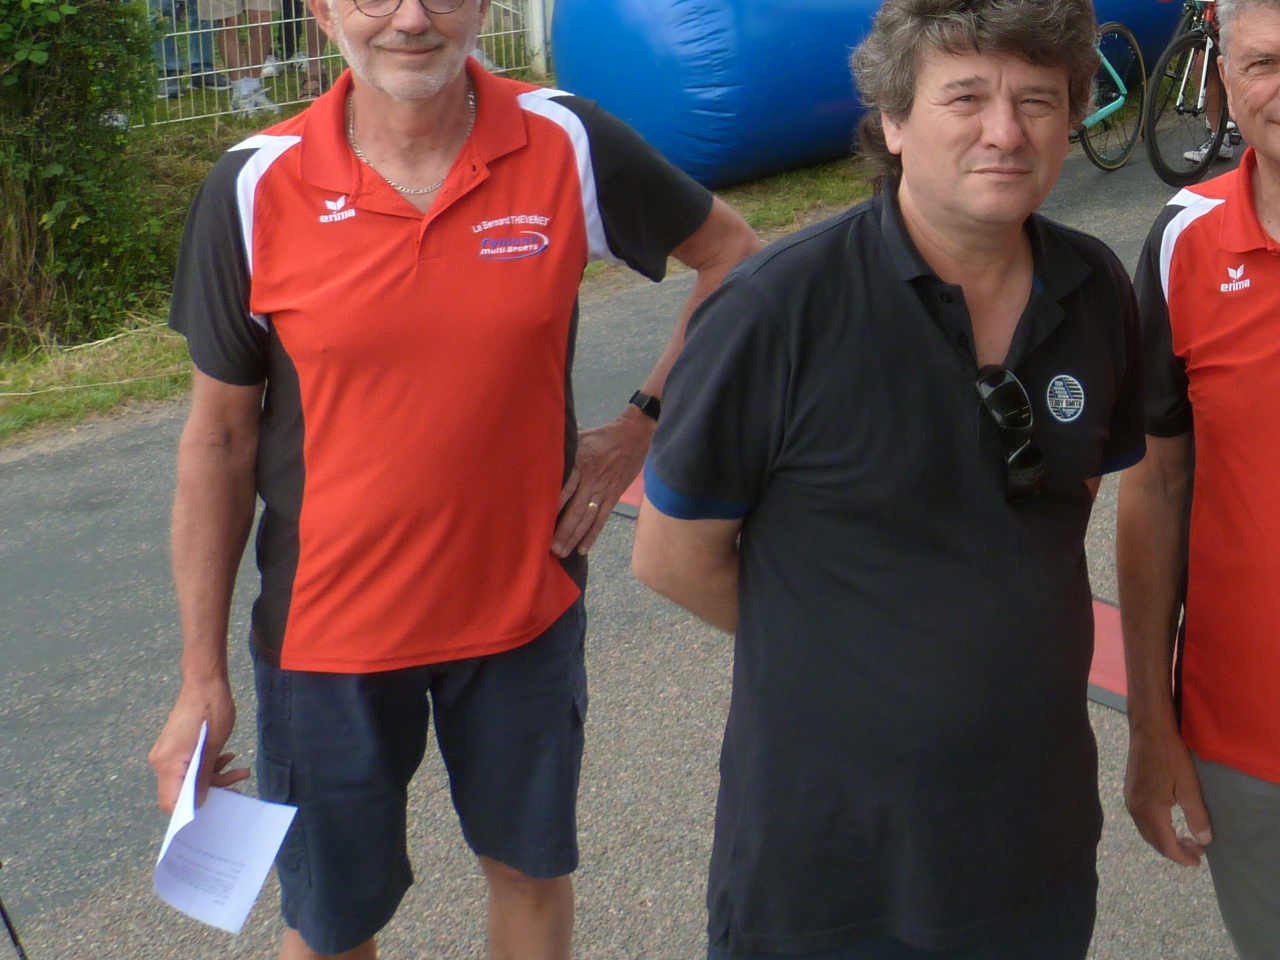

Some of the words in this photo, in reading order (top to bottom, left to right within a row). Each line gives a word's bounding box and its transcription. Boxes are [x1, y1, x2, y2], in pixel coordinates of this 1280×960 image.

[319, 208, 356, 223] erima
[472, 224, 483, 234] La
[481, 216, 511, 230] Bernard
[510, 214, 550, 227] THEVENET
[1220, 278, 1250, 292] erima
